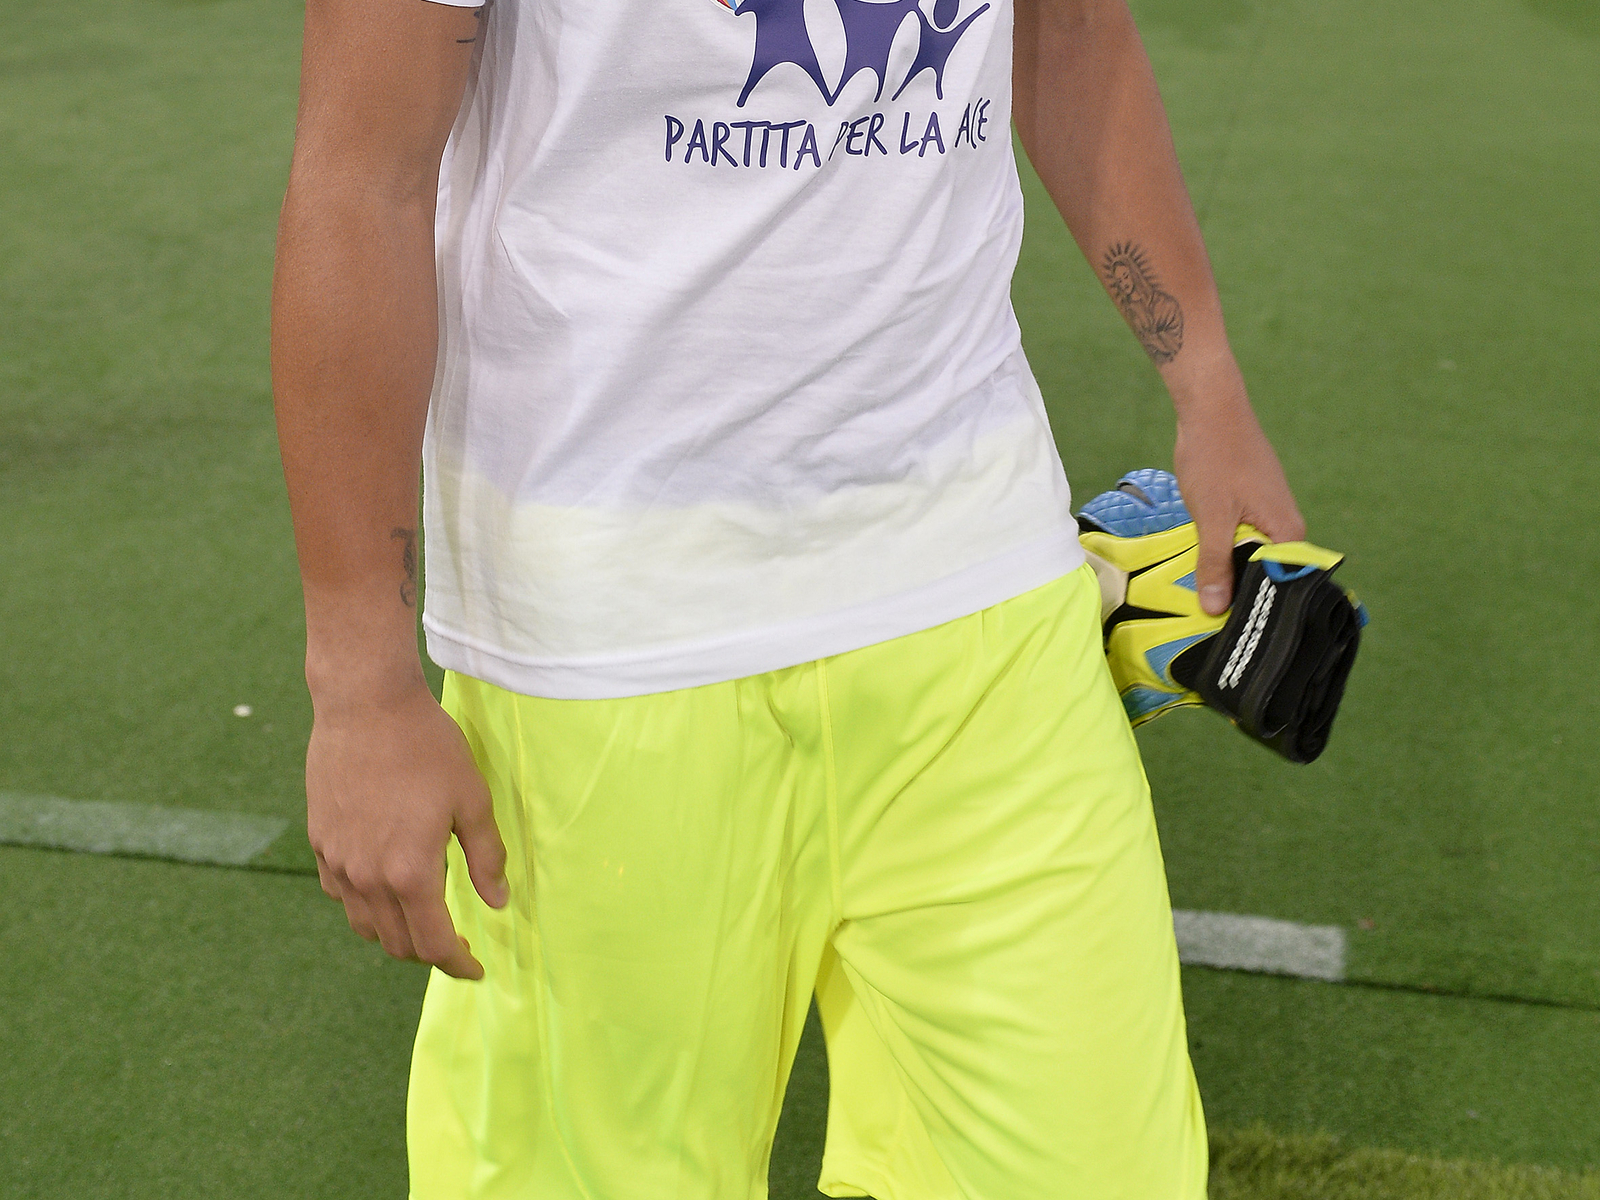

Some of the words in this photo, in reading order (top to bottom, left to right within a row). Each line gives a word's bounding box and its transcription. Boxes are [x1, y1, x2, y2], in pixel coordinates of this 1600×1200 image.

[664, 115, 821, 170] PARTITA
[828, 112, 888, 161] PER
[899, 111, 946, 157] LA
[954, 97, 991, 149] ACE
